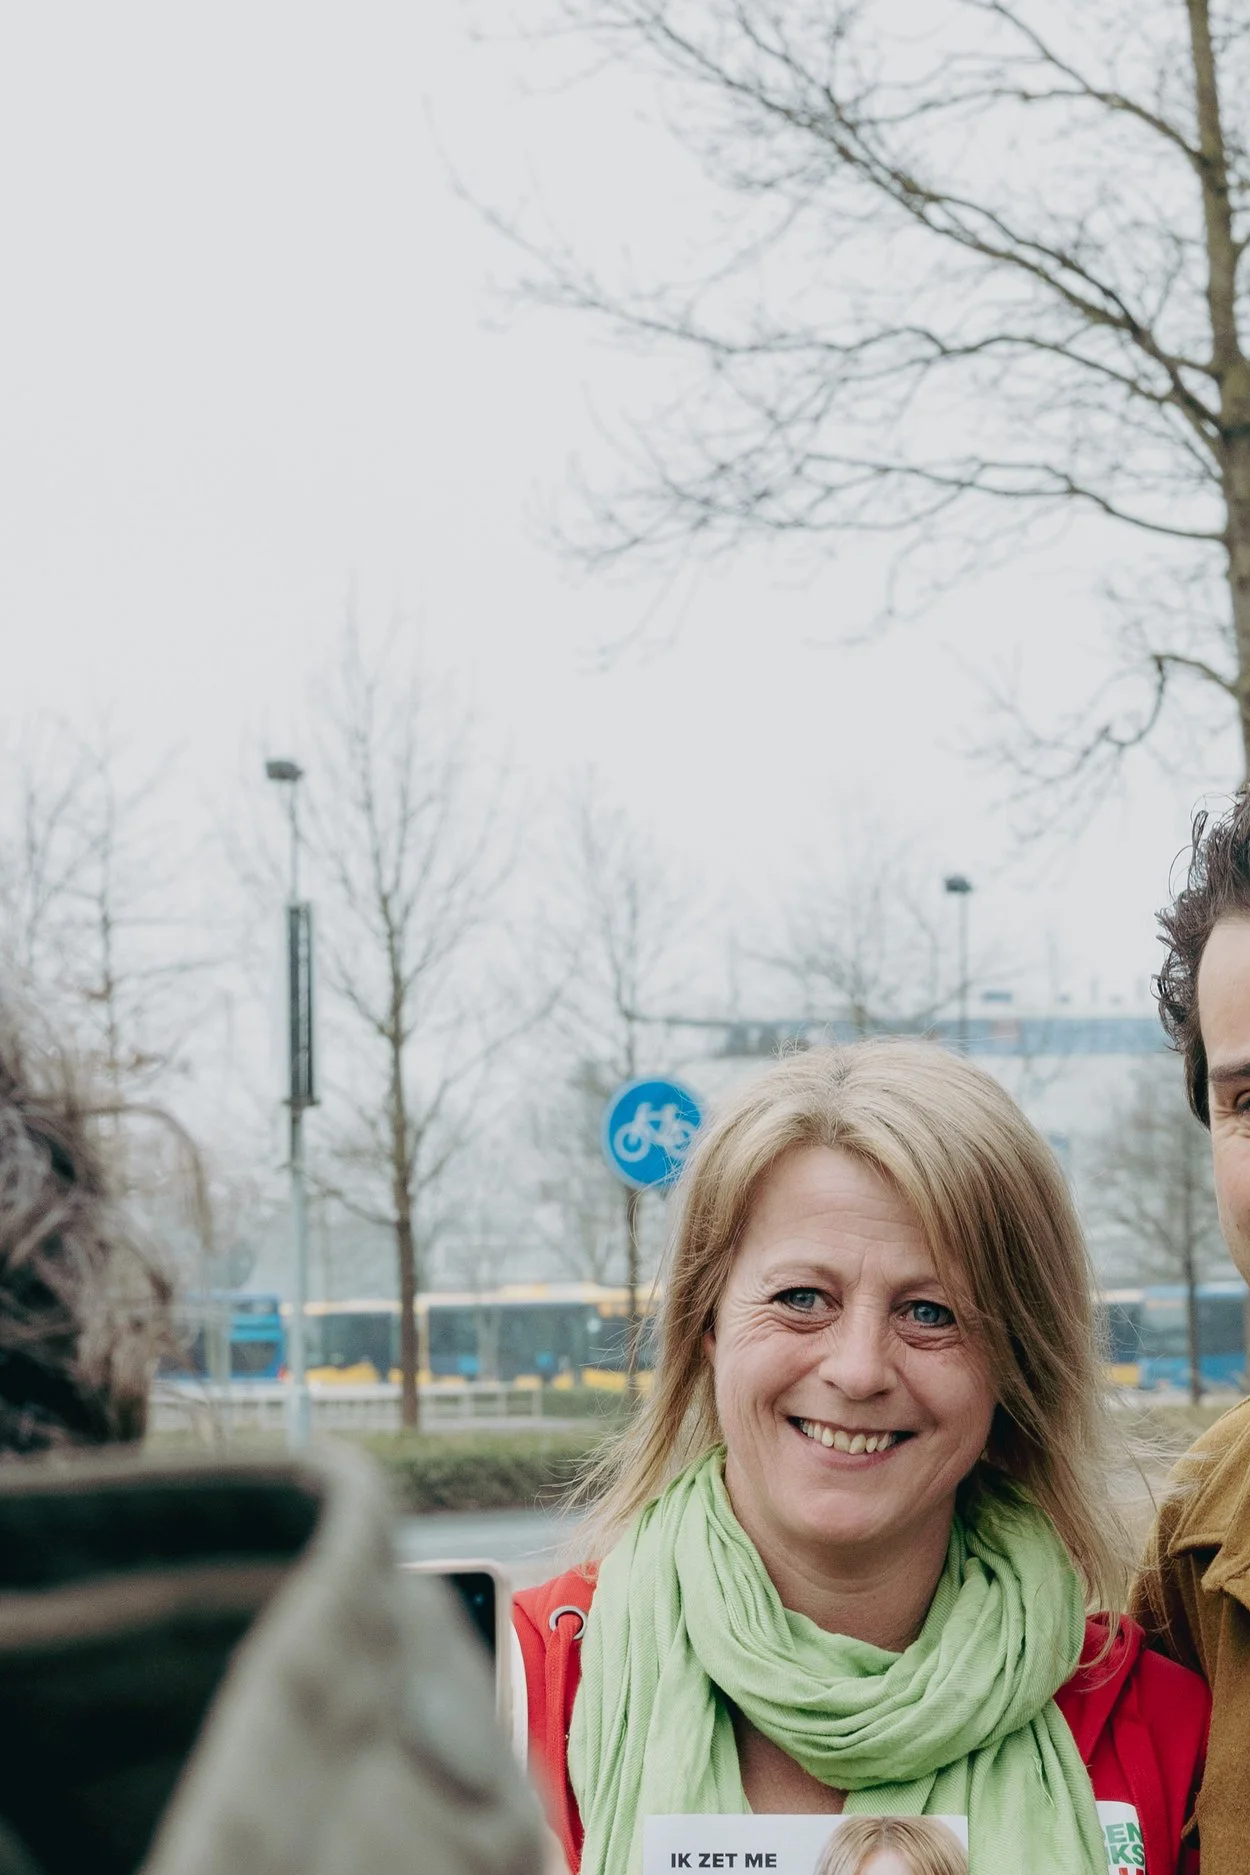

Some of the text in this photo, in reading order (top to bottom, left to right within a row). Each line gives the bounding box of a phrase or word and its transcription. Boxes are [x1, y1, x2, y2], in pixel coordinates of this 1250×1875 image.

[671, 1853, 777, 1868] IK ZET ME
